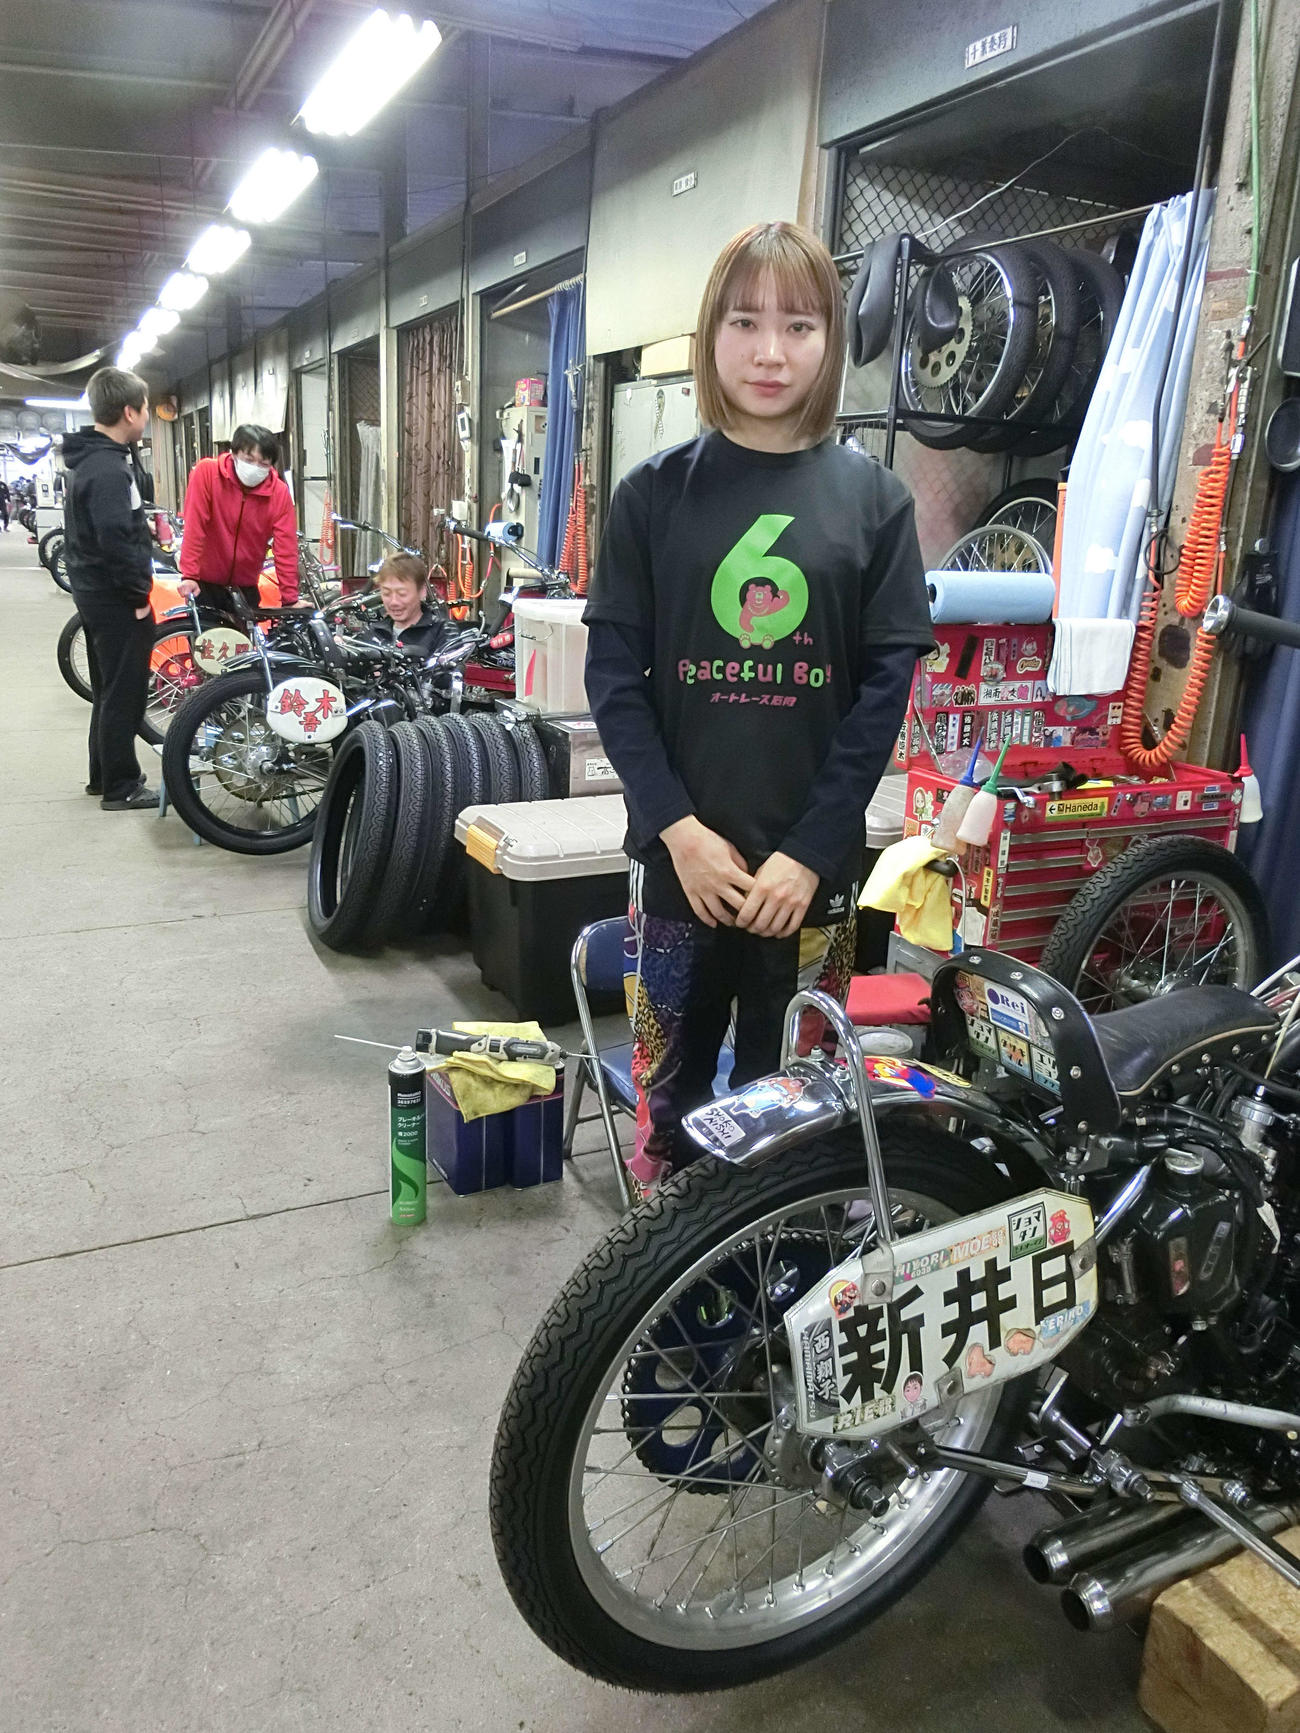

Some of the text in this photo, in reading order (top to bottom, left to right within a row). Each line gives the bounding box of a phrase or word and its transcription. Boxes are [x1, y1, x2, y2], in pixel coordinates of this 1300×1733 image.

[711, 514, 809, 644] 6
[792, 631, 813, 645] th
[677, 659, 782, 684] Peaceful
[279, 688, 337, 719] 鈴木
[299, 711, 321, 733] 吾
[1064, 801, 1099, 814] Haneda
[1000, 993, 1025, 1015] Rei
[952, 1232, 992, 1263] MOE
[838, 1239, 1076, 1404] 新井日
